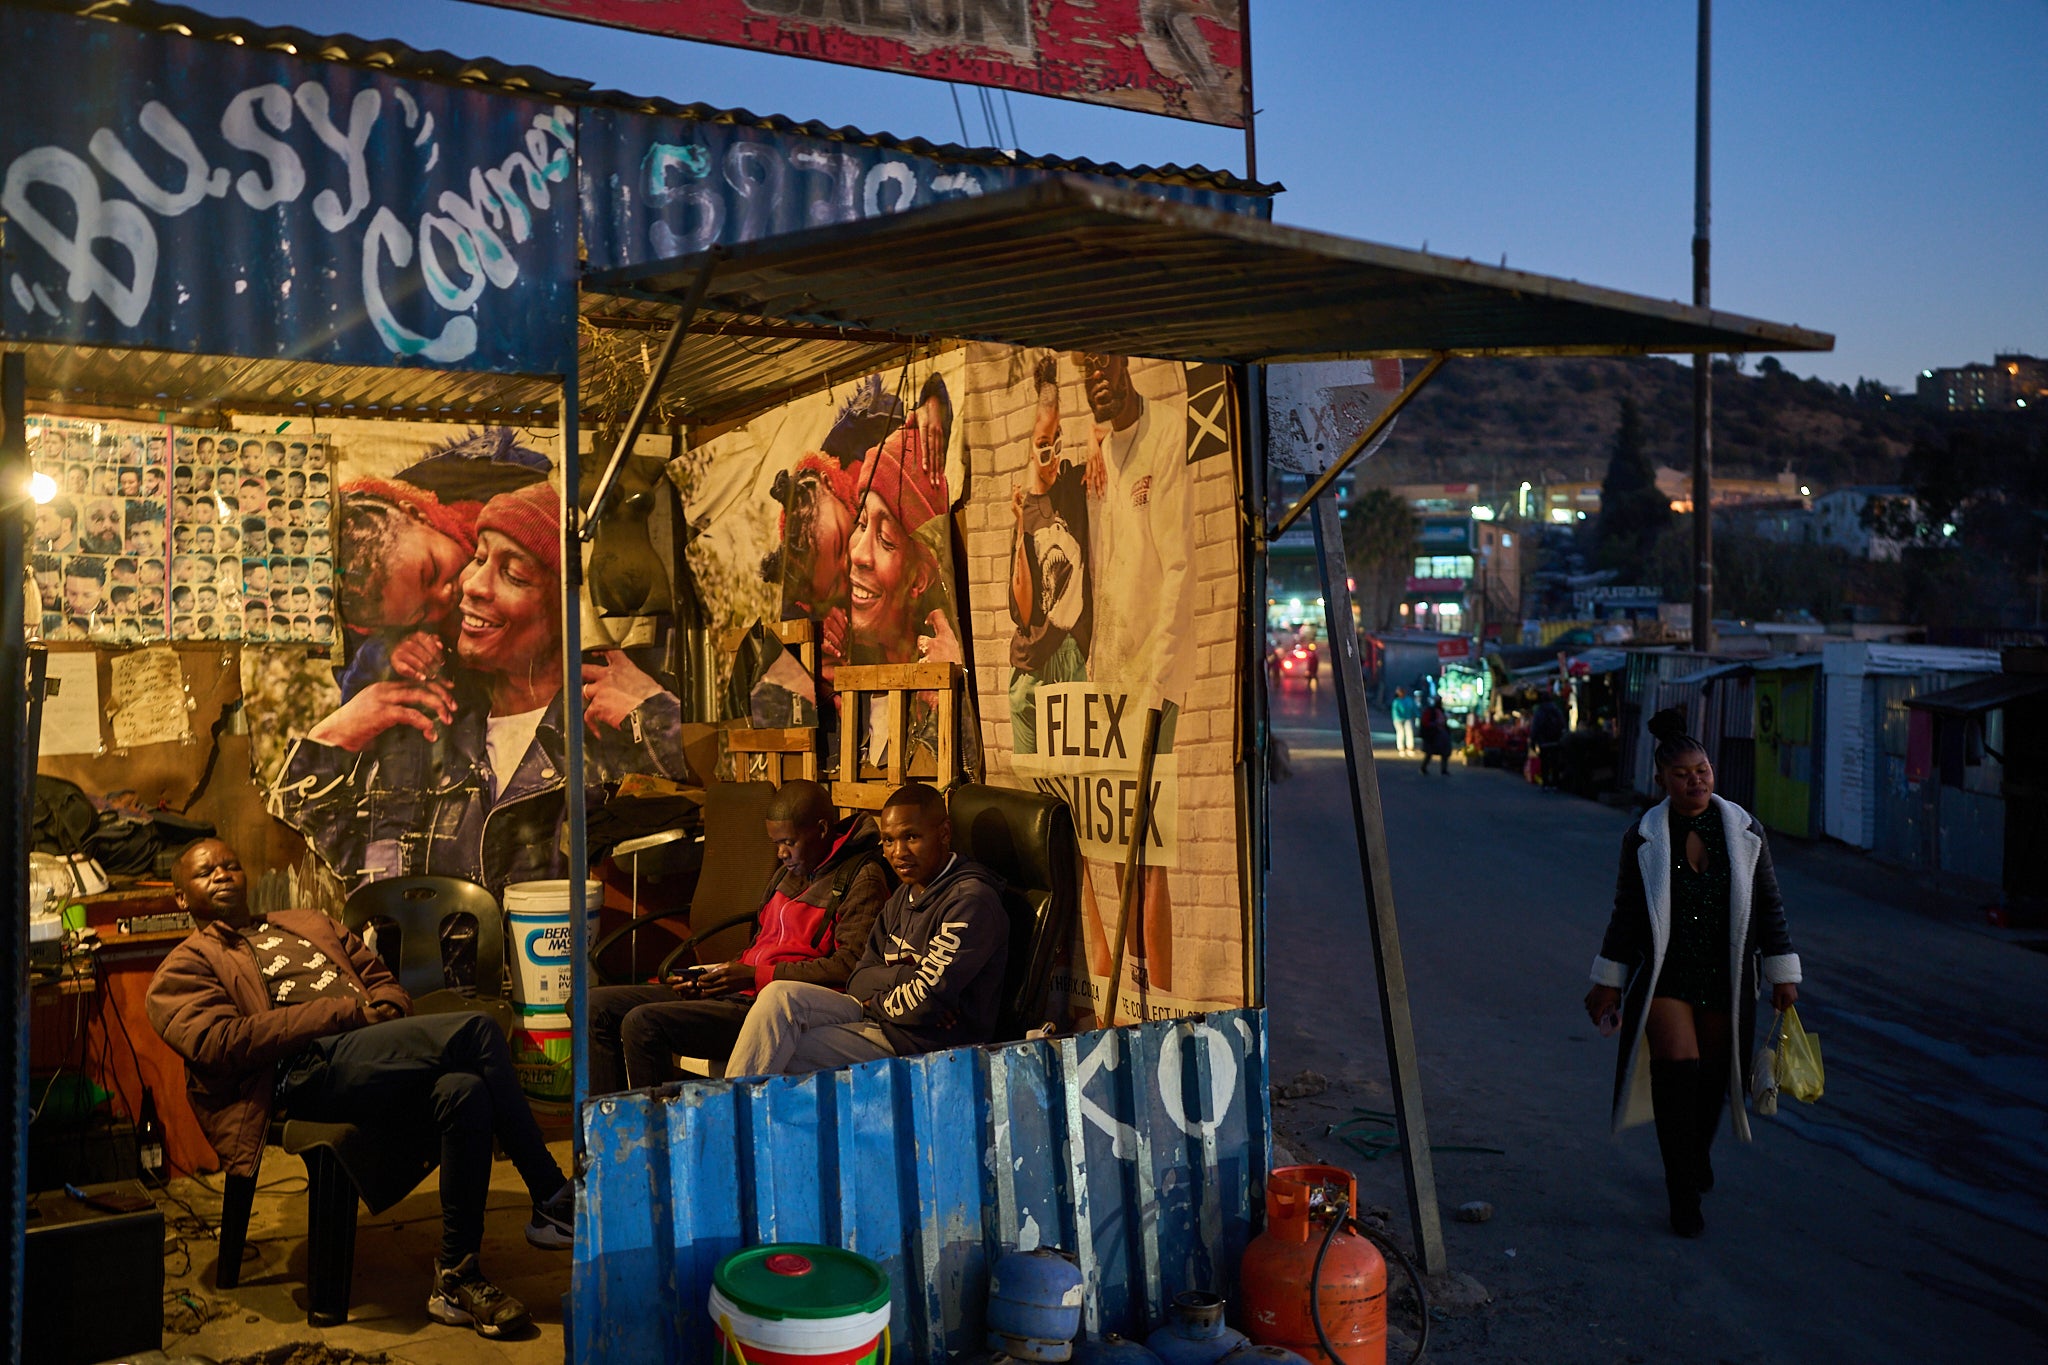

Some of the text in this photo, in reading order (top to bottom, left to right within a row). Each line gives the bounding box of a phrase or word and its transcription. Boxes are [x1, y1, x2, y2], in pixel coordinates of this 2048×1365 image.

[1046, 693, 1128, 759] FLEX
[545, 927, 571, 939] BER
[1131, 1000, 1171, 1022] COLLECT
